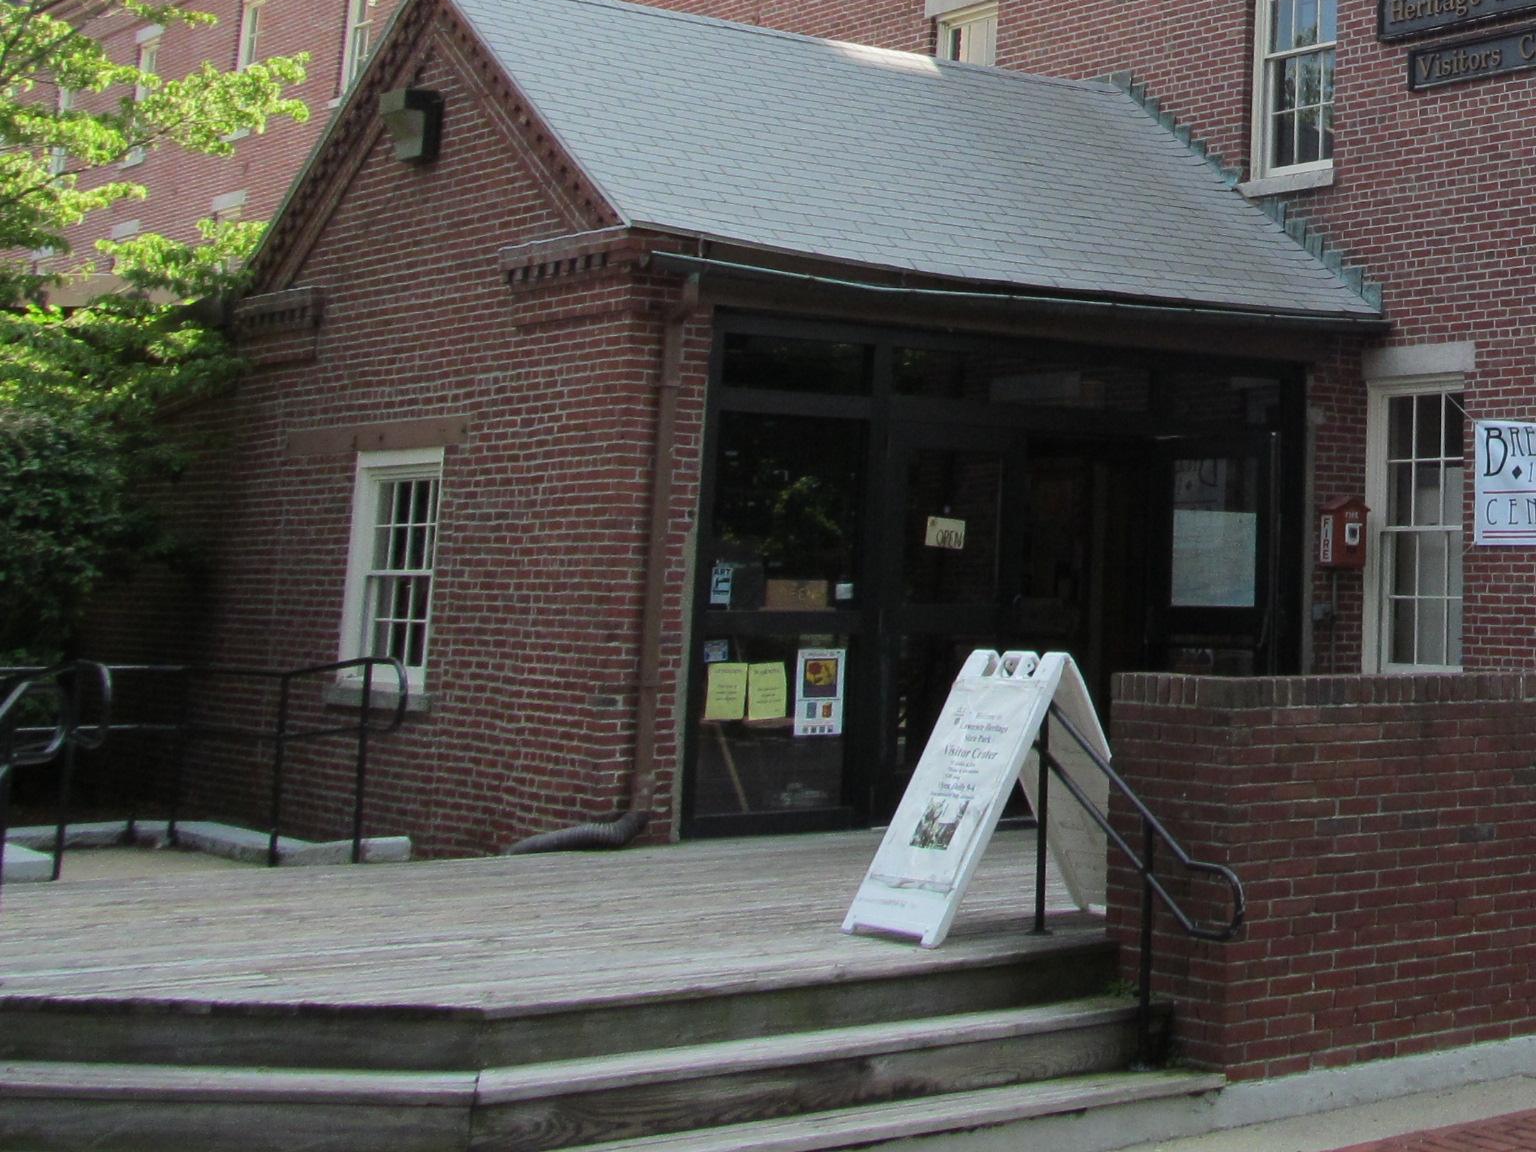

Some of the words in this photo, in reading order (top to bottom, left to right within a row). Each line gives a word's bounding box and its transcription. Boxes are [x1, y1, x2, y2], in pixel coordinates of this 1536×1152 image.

[1415, 49, 1501, 80] Visitors
[936, 528, 963, 547] OPEN
[1322, 517, 1330, 560] FIRE
